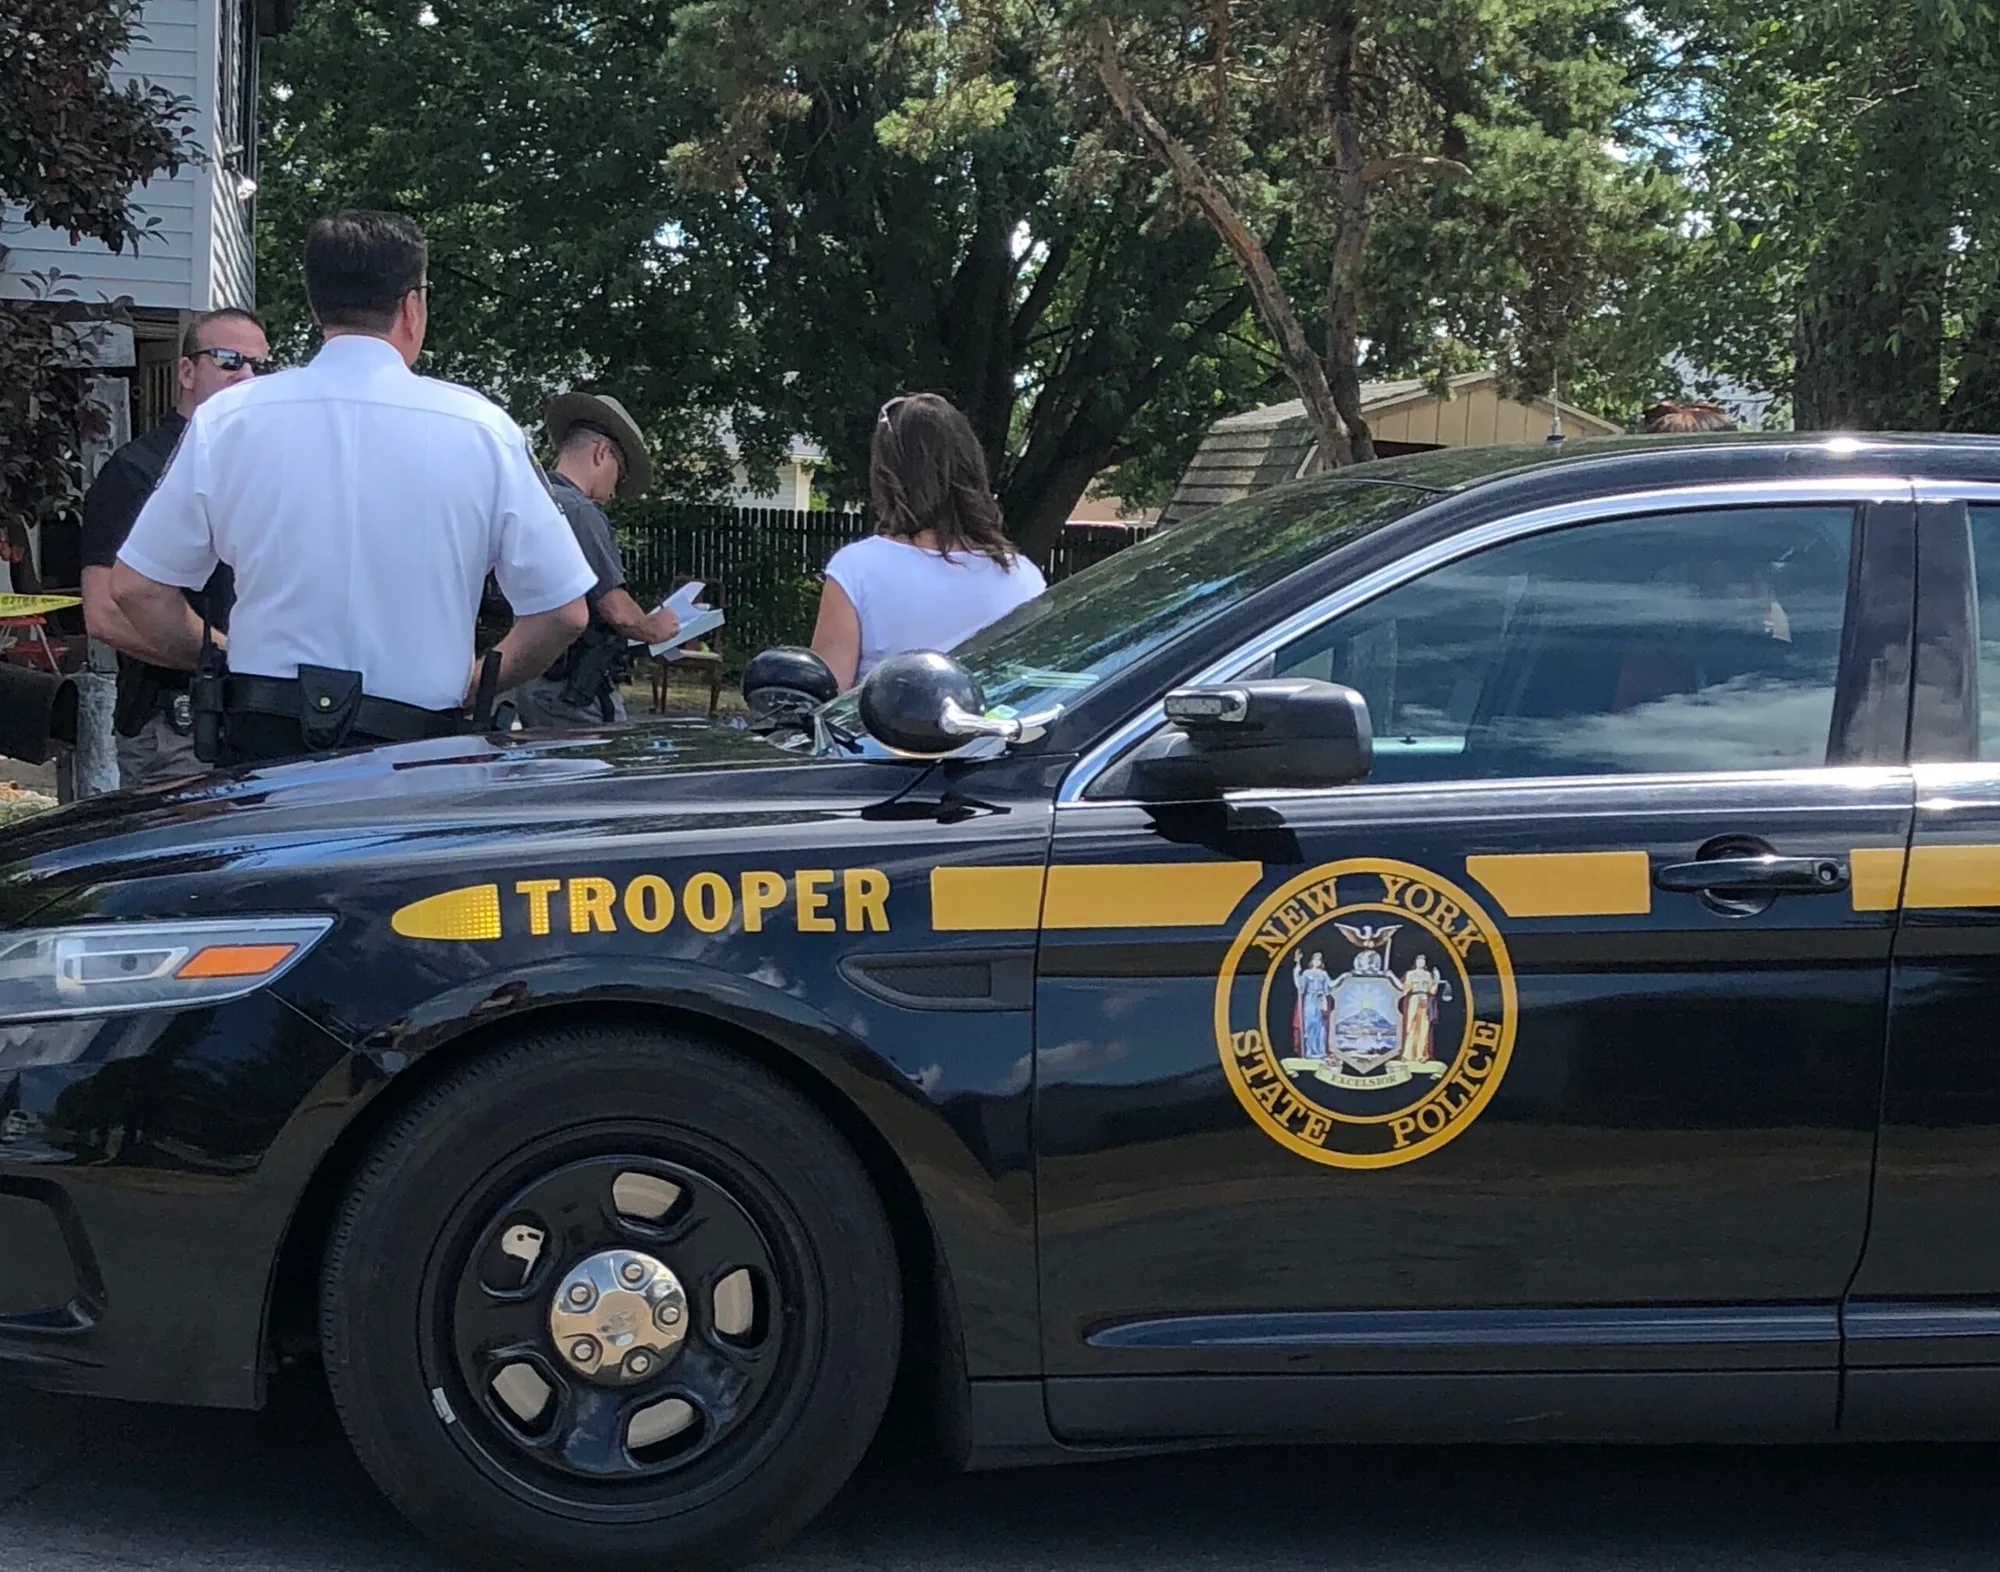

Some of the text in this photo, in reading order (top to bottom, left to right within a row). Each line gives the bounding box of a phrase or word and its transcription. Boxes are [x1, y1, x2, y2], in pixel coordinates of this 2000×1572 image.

[516, 868, 891, 935] TROOPER
[1252, 874, 1487, 958] NEW YORK
[1231, 1020, 1502, 1148] STATE POLICE
[1331, 1073, 1397, 1087] EXCELSIOR
